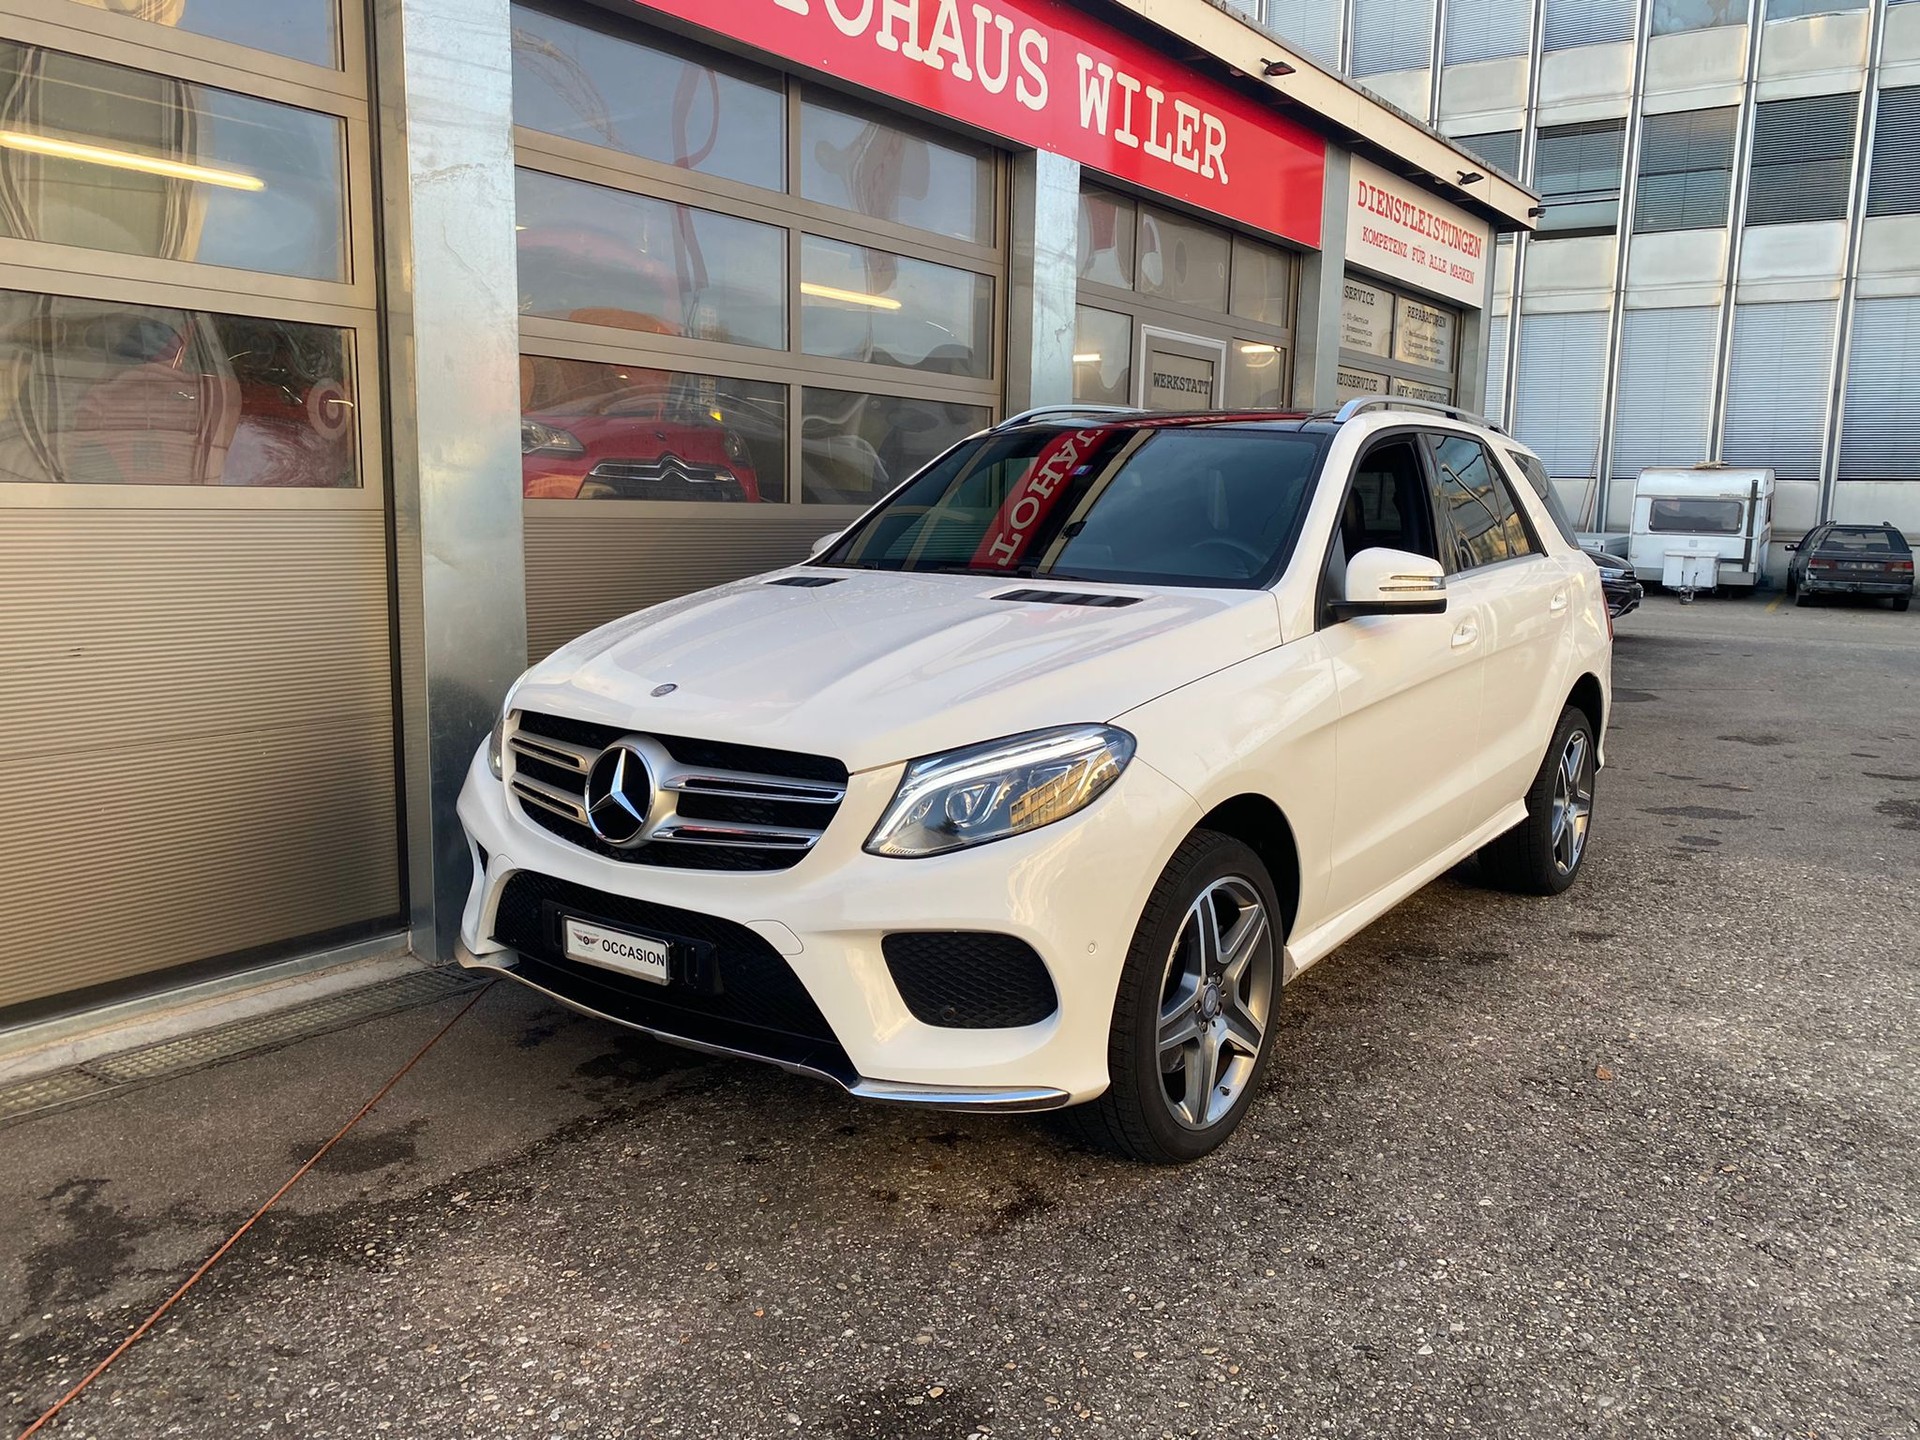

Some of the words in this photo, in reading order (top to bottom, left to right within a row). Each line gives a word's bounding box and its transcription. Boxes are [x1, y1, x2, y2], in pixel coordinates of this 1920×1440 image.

[773, 0, 1048, 111] HAUS
[1076, 52, 1229, 185] WILER
[1357, 180, 1482, 259] DIENSTLEISTUNGEN
[1362, 226, 1408, 257] KOMPETENZ
[1429, 254, 1447, 273] ALLE
[1344, 285, 1375, 306] SERVICE
[1153, 372, 1209, 395] WERKSTATT
[602, 939, 665, 967] OCCASION
